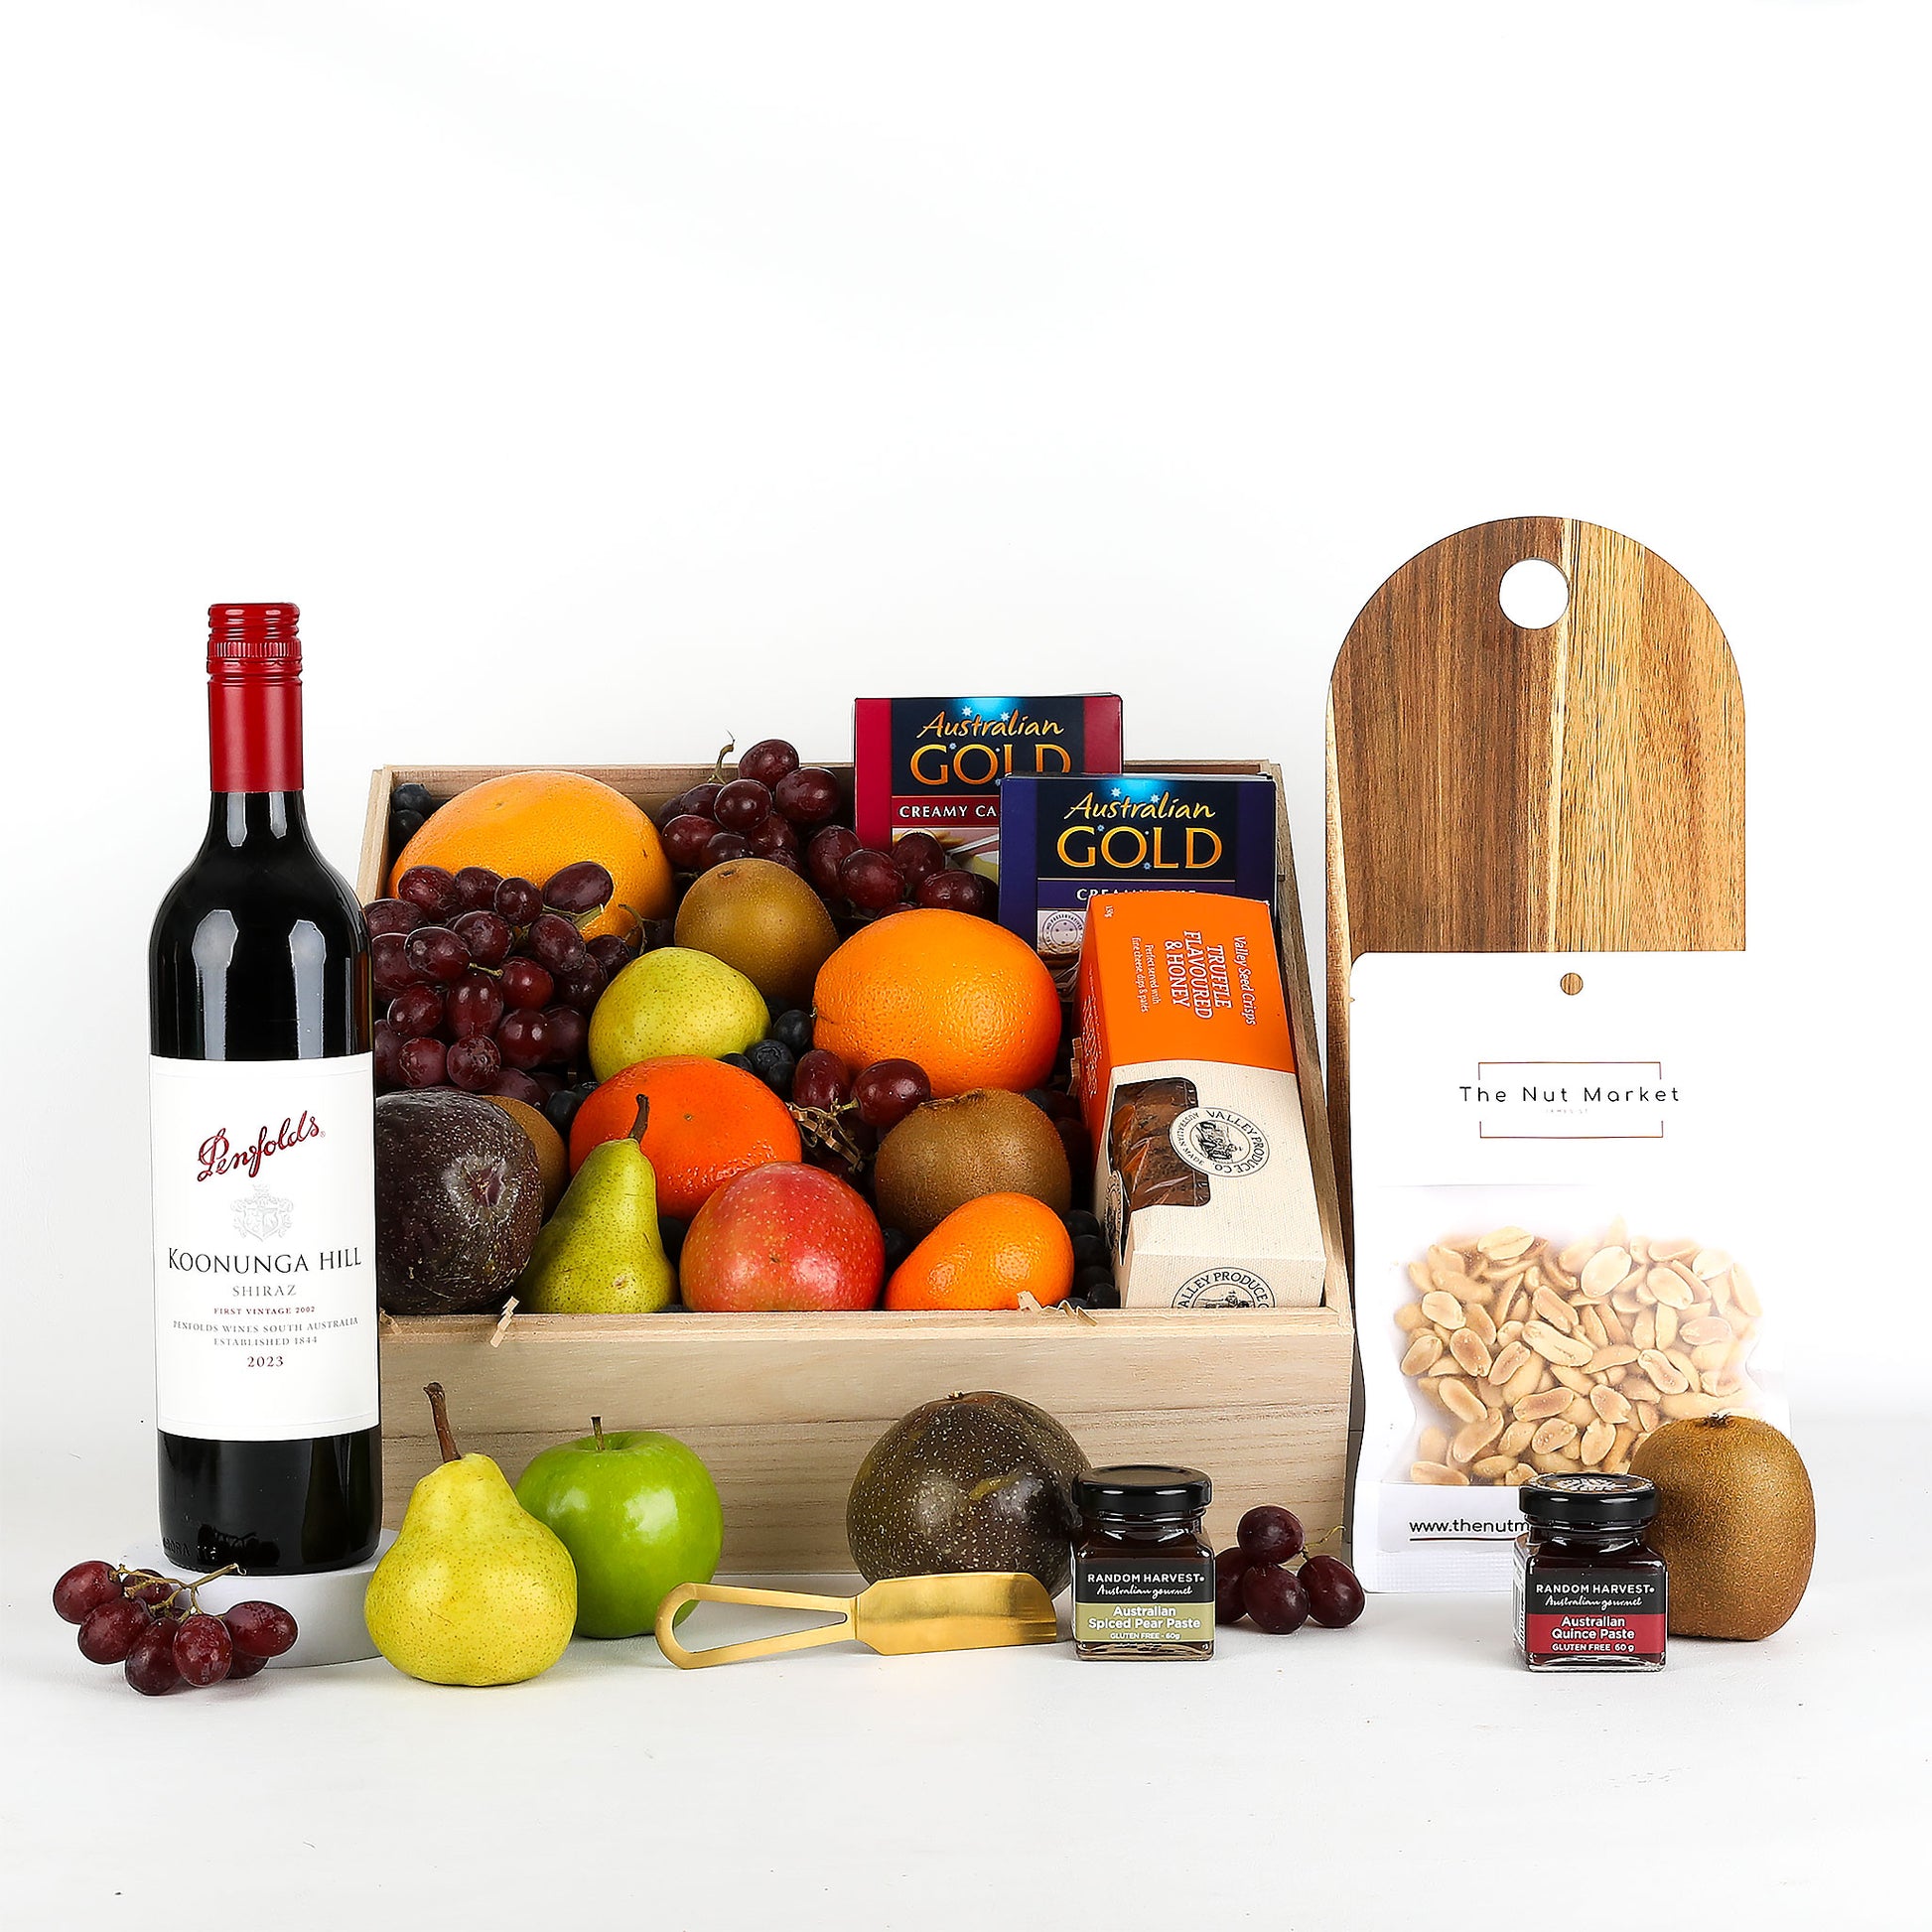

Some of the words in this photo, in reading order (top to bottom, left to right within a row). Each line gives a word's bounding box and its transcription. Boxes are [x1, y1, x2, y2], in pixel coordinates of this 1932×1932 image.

[916, 710, 1065, 739] Australian
[909, 744, 1071, 785] GOLD
[899, 805, 967, 818] CREAMY
[1064, 791, 1215, 820] Australian
[1057, 825, 1222, 869] GOLD
[1165, 940, 1183, 950] &
[1234, 936, 1248, 967] Valley
[1167, 953, 1190, 1007] HONEY
[1183, 930, 1213, 1019] FLAVOURED
[1206, 945, 1232, 1009] TRUFFLE
[1238, 967, 1254, 991] Seed
[1241, 993, 1257, 1025] Crisps
[1459, 1086, 1507, 1102] The
[1523, 1086, 1568, 1102] Nut
[1584, 1086, 1679, 1102] Market
[197, 1110, 320, 1181] Penfolds
[1205, 1109, 1257, 1135] VALLEY
[1233, 1137, 1265, 1173] PRODUCE
[1182, 1148, 1205, 1166] MADE
[168, 1247, 310, 1274] KOONUNGA
[320, 1247, 361, 1270] HILL
[232, 1285, 297, 1297] SHIRAZ
[1177, 1275, 1210, 1309] ALLEY
[1213, 1271, 1269, 1303] PRODUCE
[307, 1316, 358, 1330] AUSTRALIA
[246, 1356, 284, 1368] 2023
[1087, 1574, 1141, 1584] RANDOM
[1096, 1585, 1152, 1595] Australian
[1152, 1586, 1193, 1599] gourmet
[1536, 1585, 1590, 1593] RANDOM
[1113, 1605, 1176, 1617] Australian
[1545, 1595, 1601, 1606] Australian
[1601, 1595, 1642, 1610] gourmet
[1088, 1618, 1132, 1630] Spiced
[1134, 1618, 1164, 1629] Pear
[1166, 1618, 1201, 1629] Paste
[1561, 1615, 1625, 1627] Australian
[1551, 1628, 1596, 1639] Quince
[1600, 1628, 1635, 1639] Paste
